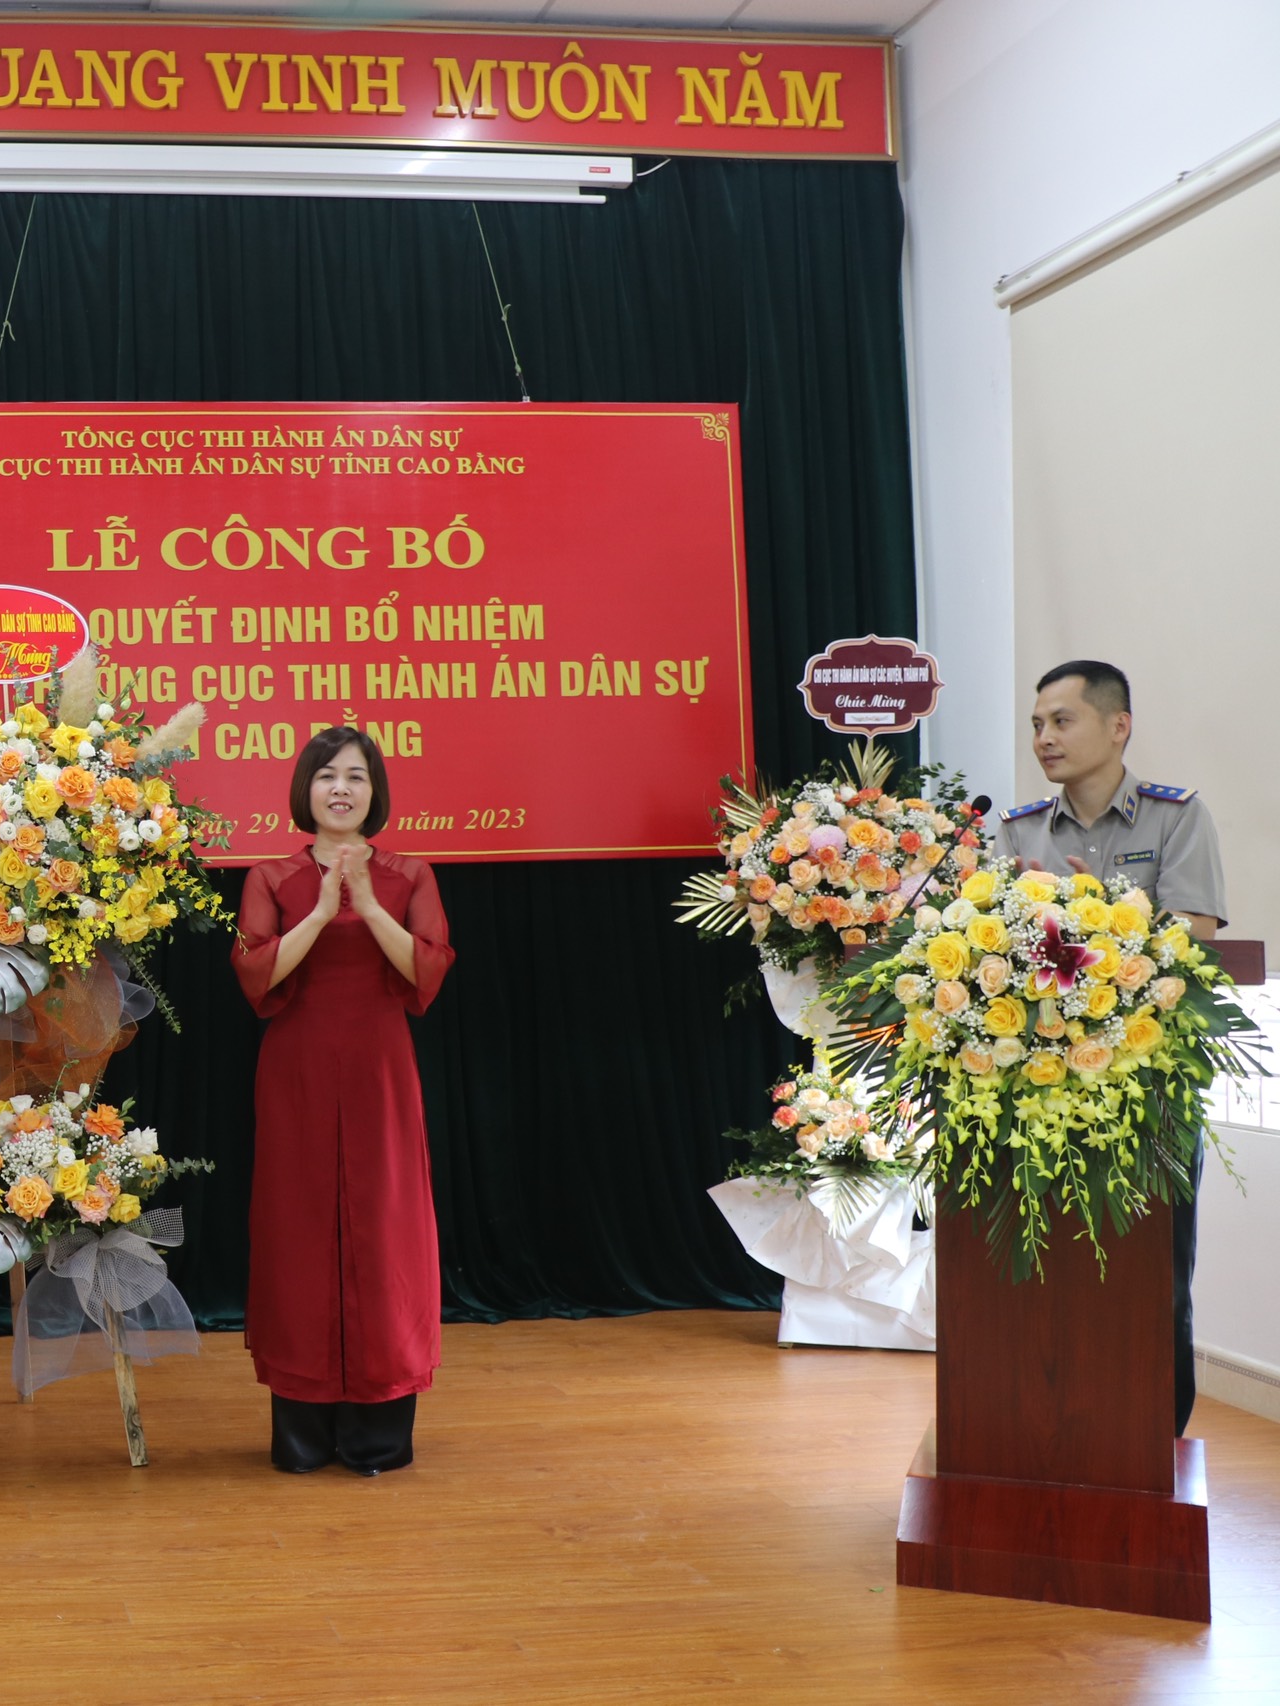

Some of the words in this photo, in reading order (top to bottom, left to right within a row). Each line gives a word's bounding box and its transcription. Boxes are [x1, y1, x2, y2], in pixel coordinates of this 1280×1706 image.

[205, 52, 407, 115] VINH
[434, 41, 651, 122] MUÔN
[677, 50, 844, 129] NĂM
[61, 425, 135, 449] TỔNG
[140, 430, 194, 452] CỤC
[199, 430, 245, 448] THI
[251, 425, 324, 448] HÀNH
[332, 424, 366, 448] ÁN
[371, 424, 423, 448] DÂN
[429, 427, 464, 452] SỰ
[57, 457, 102, 476] THI
[110, 452, 183, 476] HÀNH
[190, 452, 225, 475] ÁN
[231, 451, 284, 475] DÂN
[290, 454, 325, 479] SỰ
[329, 451, 391, 475] TỈNH
[396, 456, 451, 475] CAO
[457, 452, 525, 475] BẰNG
[46, 515, 140, 572] LỄ
[160, 513, 369, 571] CÔNG
[387, 513, 485, 569] BỐ
[89, 595, 218, 647] QUYẾT
[230, 606, 331, 652] ĐỊNH
[345, 590, 400, 643] BỔ
[413, 596, 545, 649] NHIỆM
[192, 664, 275, 710] CỤC
[287, 663, 351, 701] THI
[365, 655, 477, 700] HÀNH
[490, 654, 546, 698] ÁN
[559, 653, 641, 697] DÂN
[655, 656, 710, 704] SỰ
[835, 695, 866, 708] Chúc
[867, 694, 906, 710] Mừng
[214, 722, 296, 761] CAO
[246, 812, 280, 834] 29
[397, 811, 454, 831] năm
[465, 808, 526, 830] 2023
